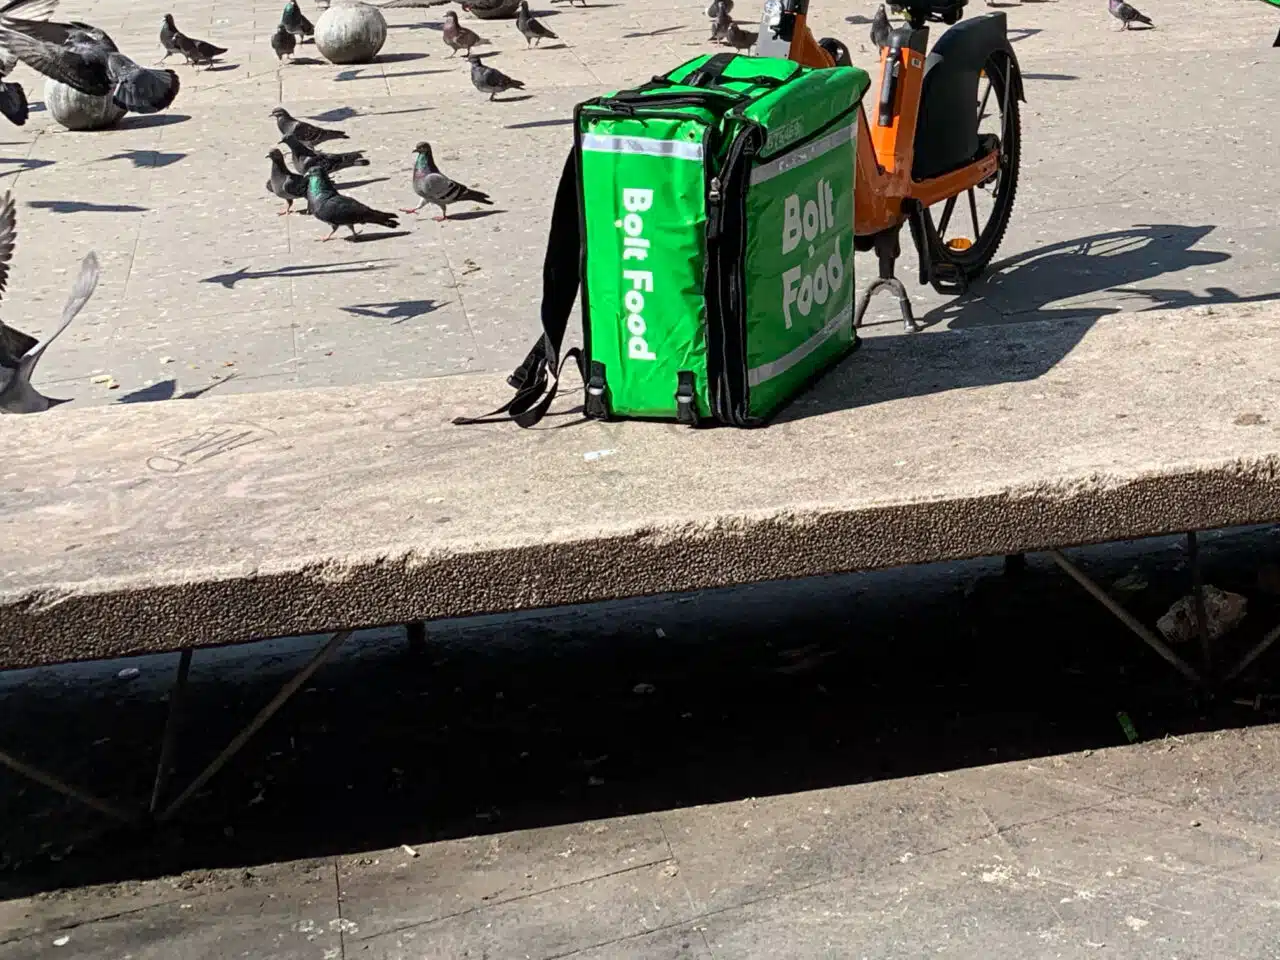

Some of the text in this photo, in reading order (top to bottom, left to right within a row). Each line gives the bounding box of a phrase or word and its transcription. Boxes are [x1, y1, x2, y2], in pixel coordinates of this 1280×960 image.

[782, 177, 834, 255] Bolt
[622, 188, 657, 360] Bolt Food
[782, 235, 844, 330] Food
